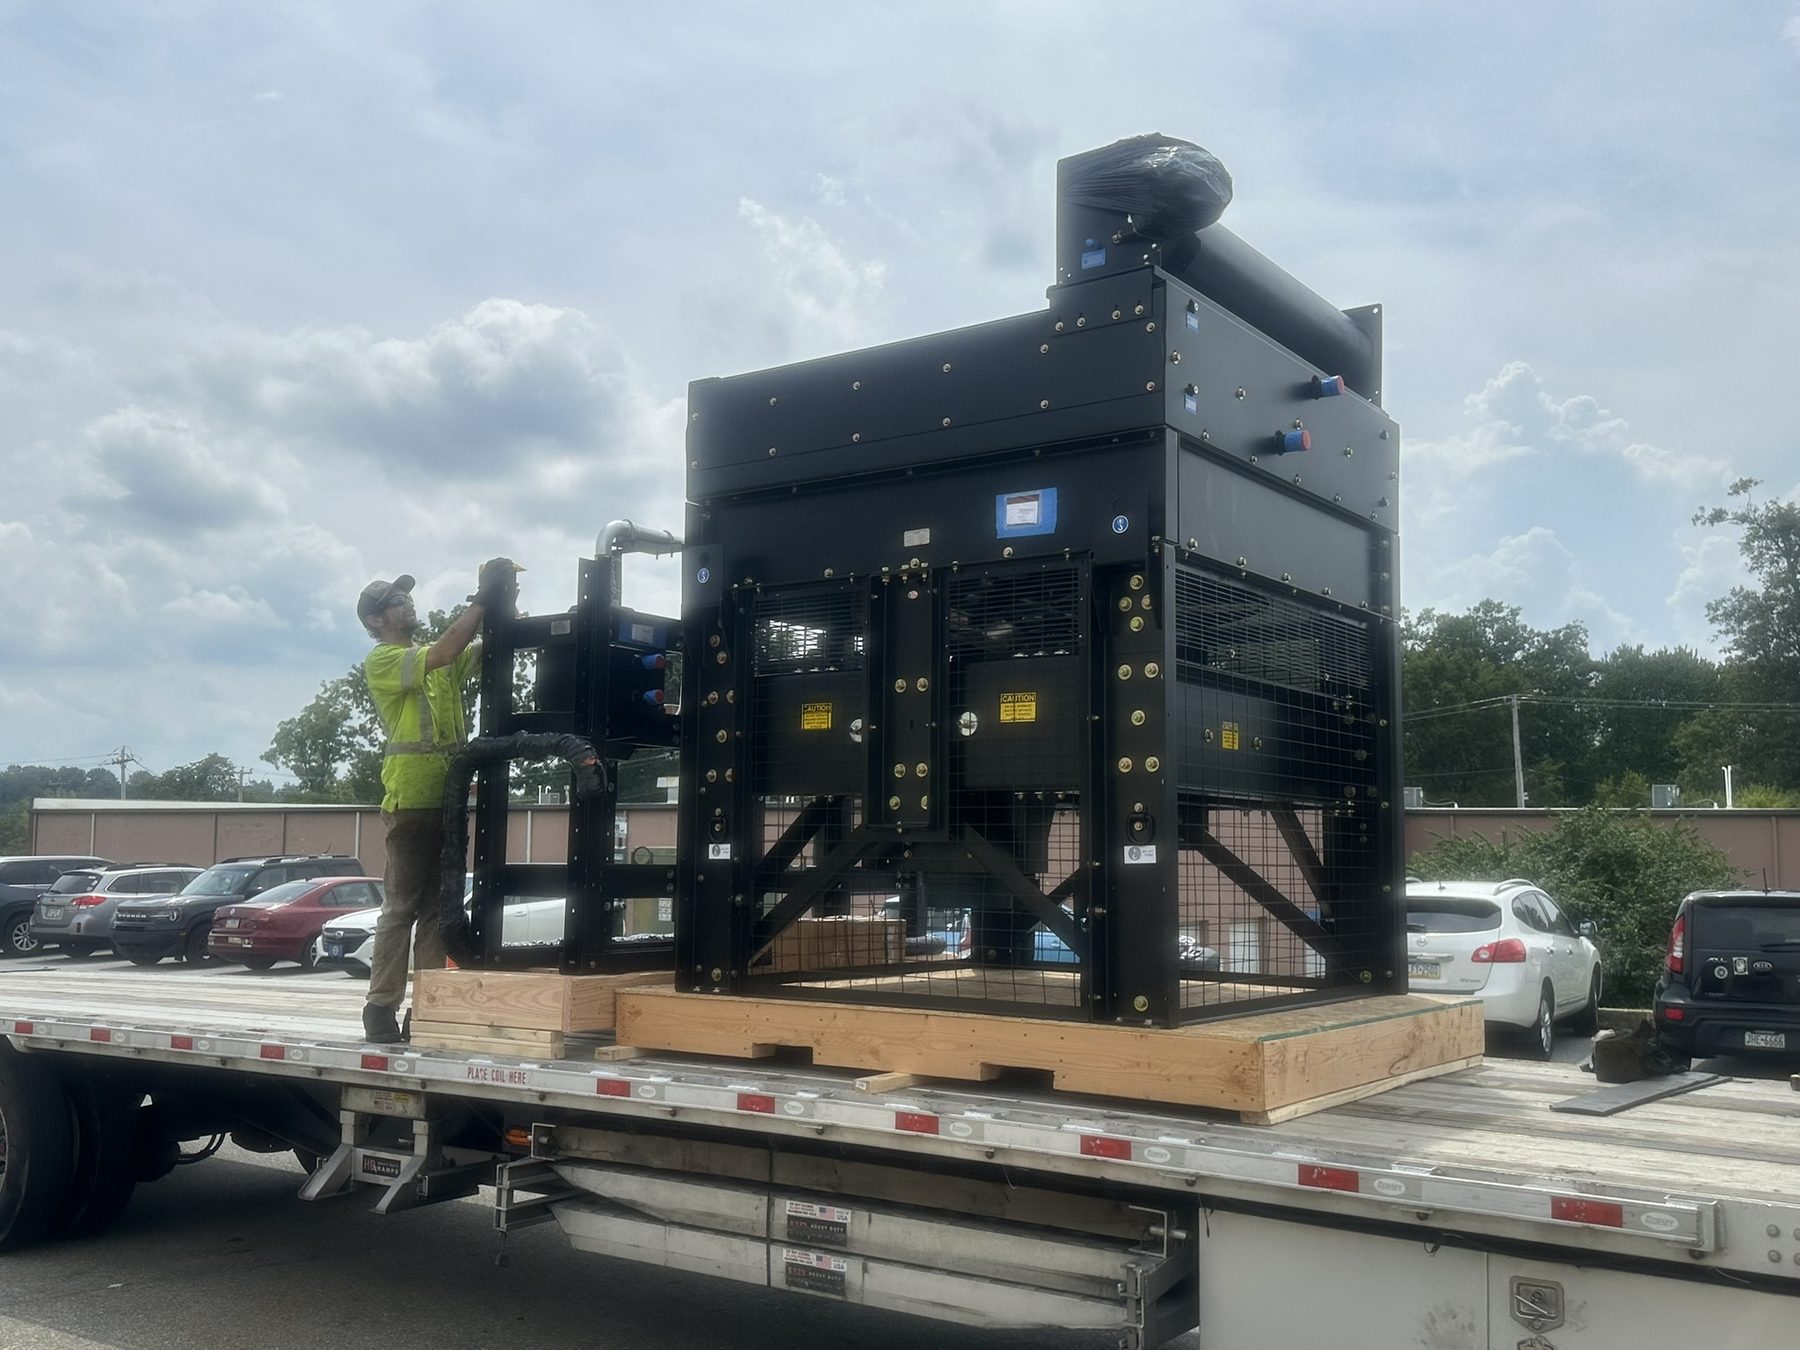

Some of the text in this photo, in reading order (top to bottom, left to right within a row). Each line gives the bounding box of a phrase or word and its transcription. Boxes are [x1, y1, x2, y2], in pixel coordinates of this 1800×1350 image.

[1002, 694, 1035, 703] CAUTION
[491, 1069, 506, 1083] COIL
[509, 1071, 527, 1085] HERE
